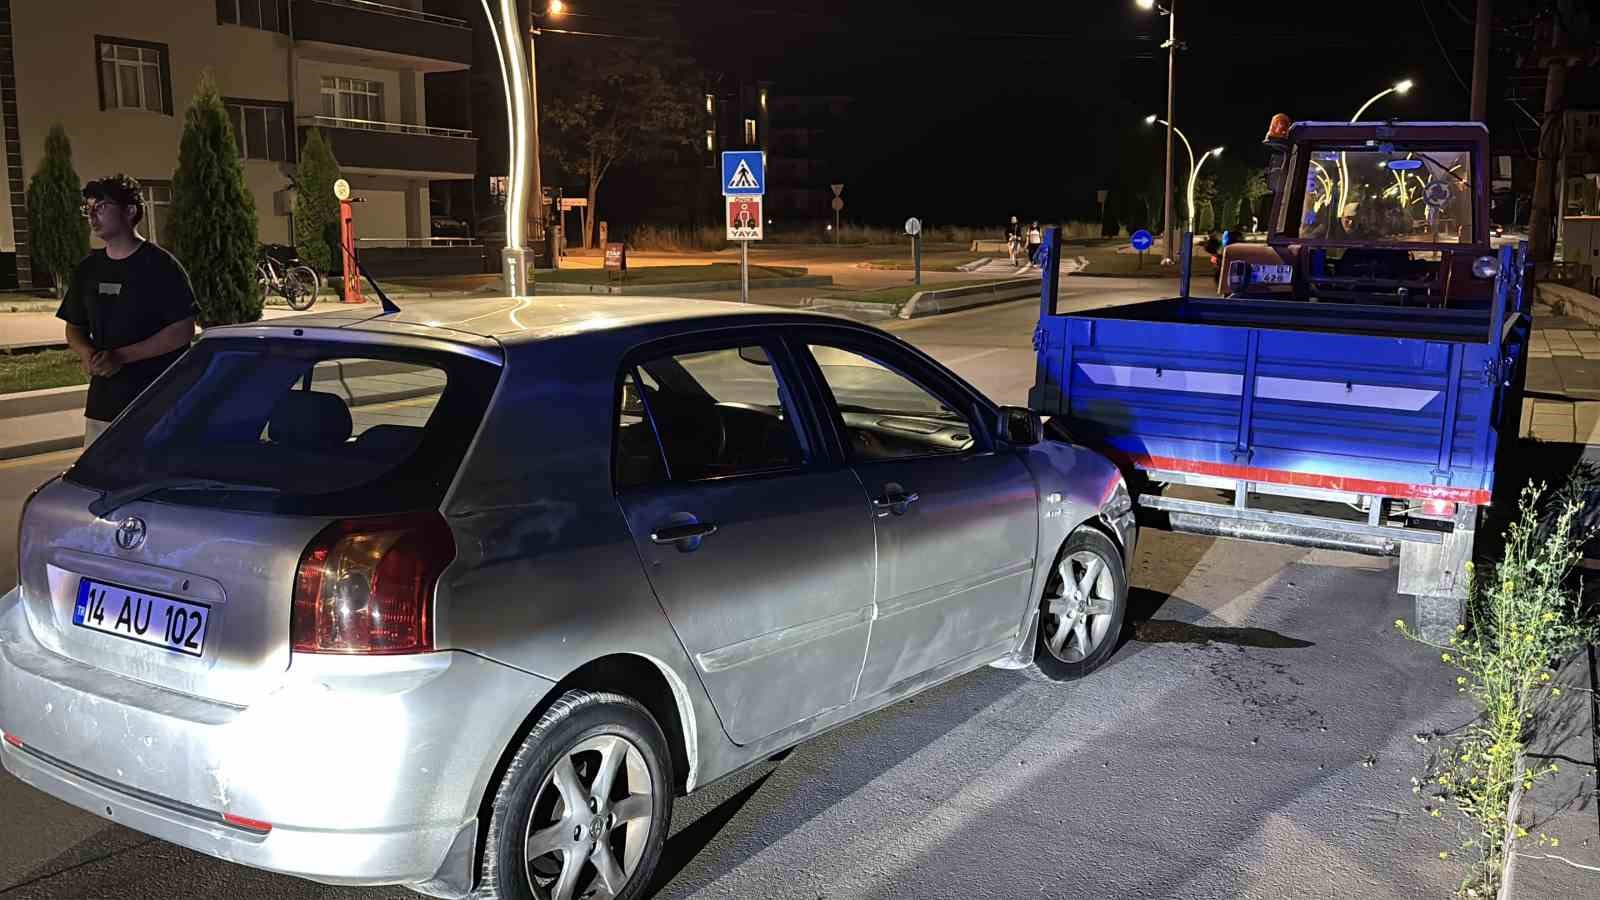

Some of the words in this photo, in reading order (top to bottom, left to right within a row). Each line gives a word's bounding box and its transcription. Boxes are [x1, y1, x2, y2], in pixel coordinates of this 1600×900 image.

[87, 588, 107, 626] 14
[115, 596, 153, 635] AU
[164, 605, 202, 649] 102
